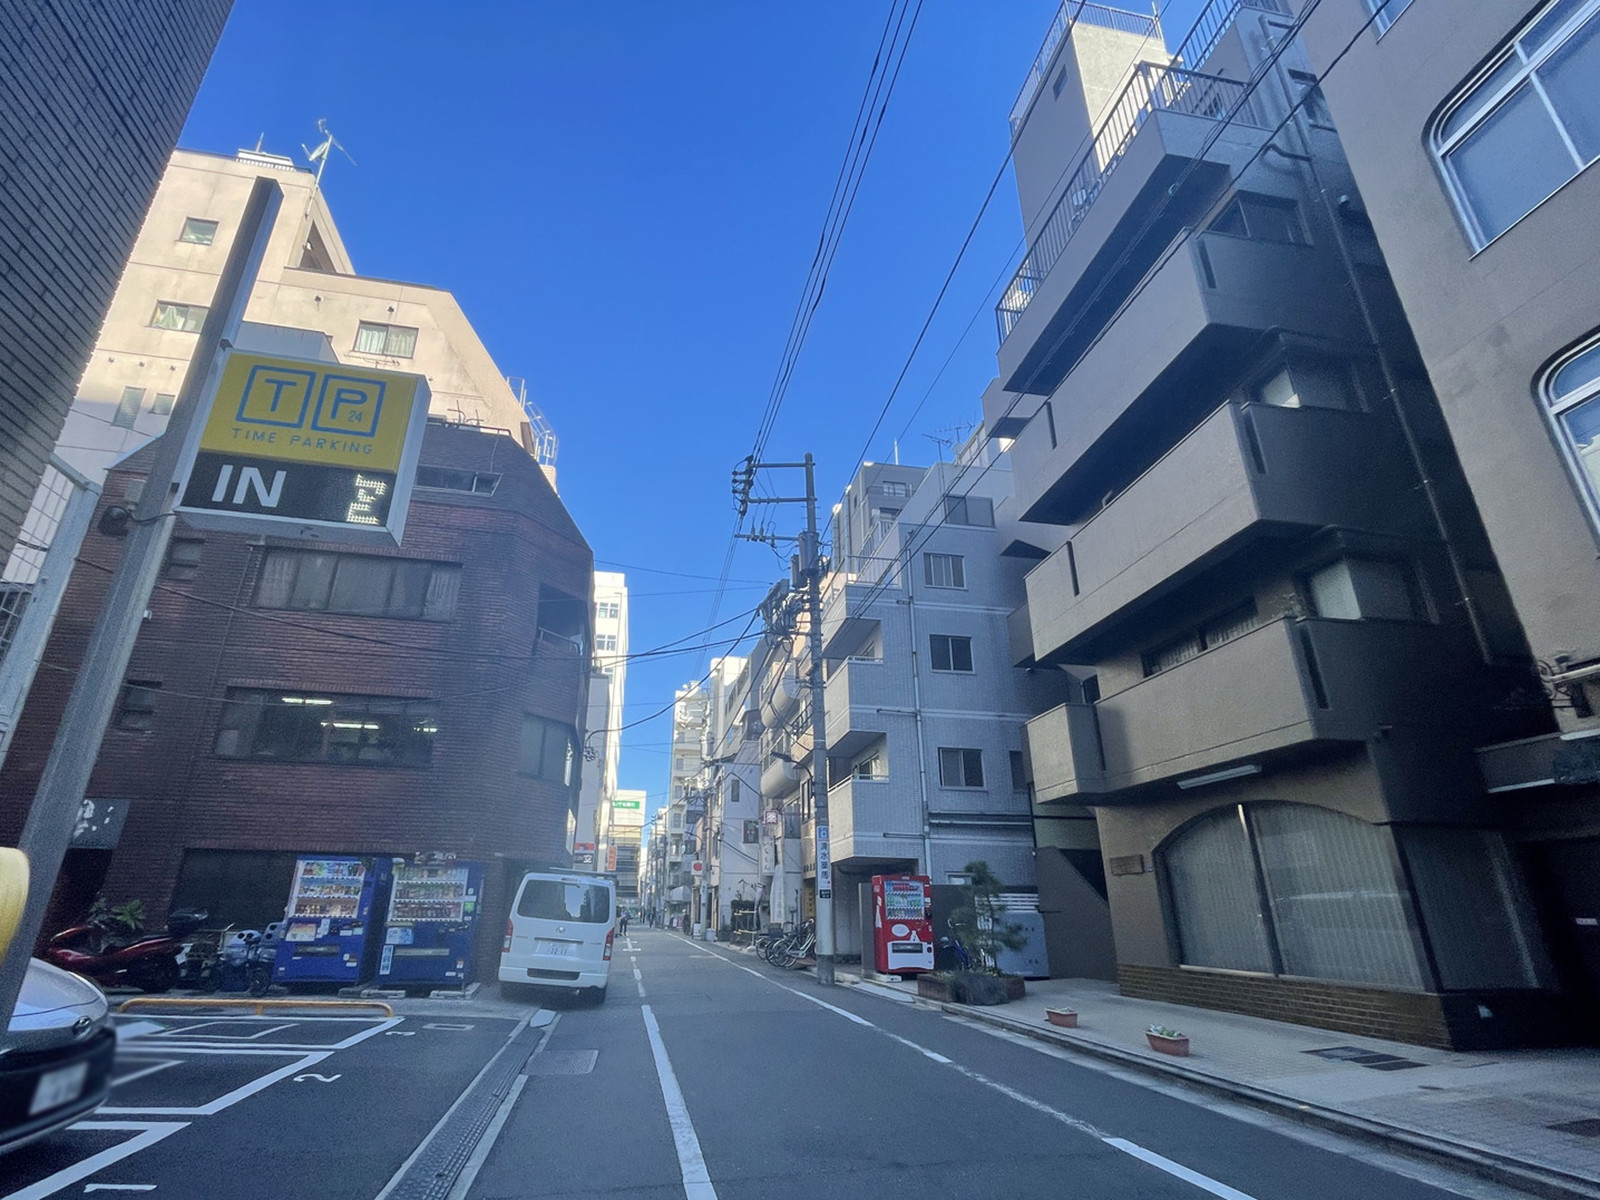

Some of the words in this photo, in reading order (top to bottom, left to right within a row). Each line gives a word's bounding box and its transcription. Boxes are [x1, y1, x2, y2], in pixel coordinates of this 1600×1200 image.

[347, 410, 363, 423] 24
[231, 428, 277, 444] TIME
[289, 434, 374, 455] PARKING
[211, 464, 287, 508] IN
[293, 1072, 343, 1083] 2
